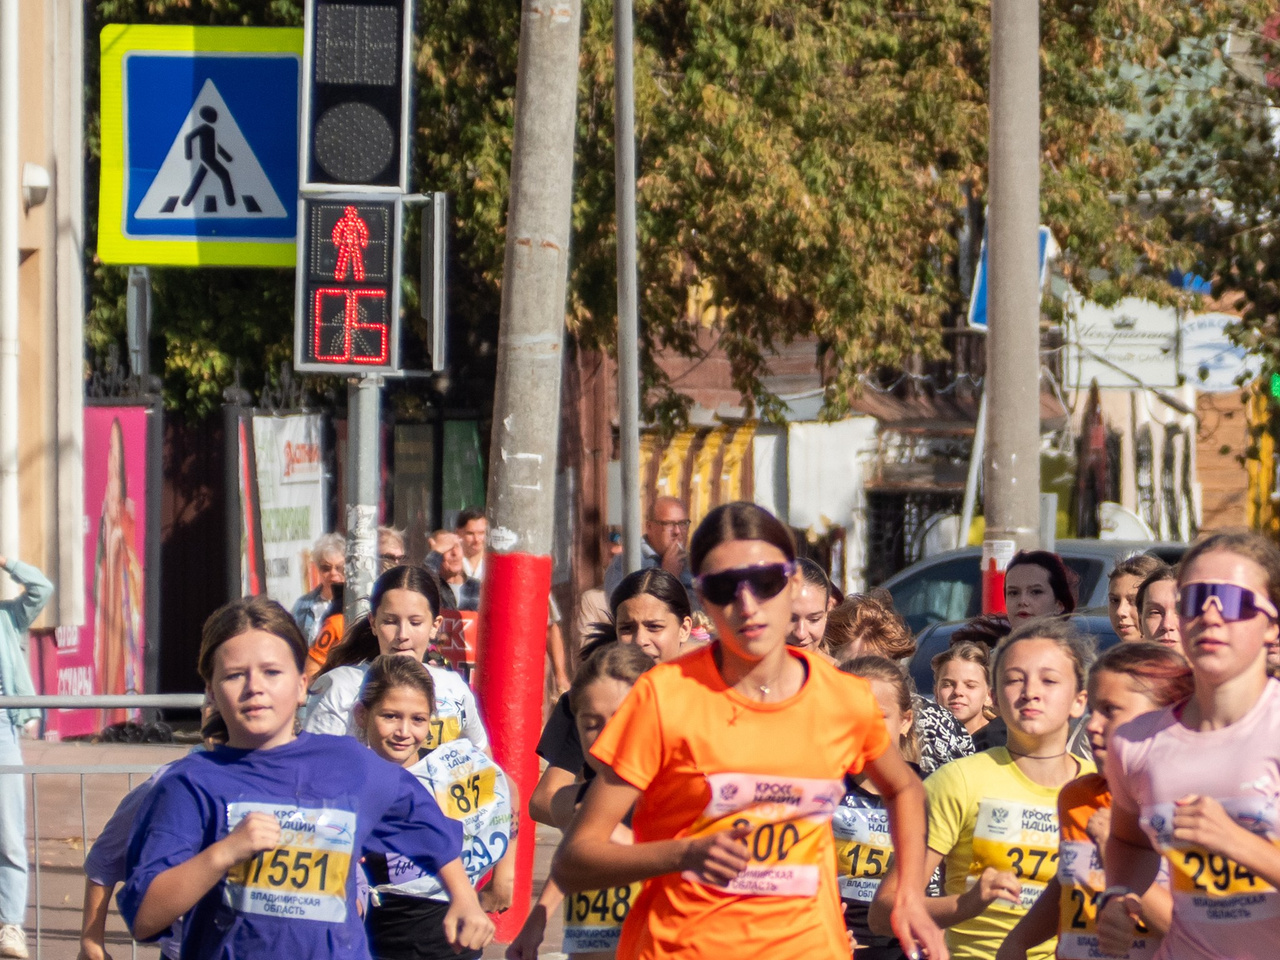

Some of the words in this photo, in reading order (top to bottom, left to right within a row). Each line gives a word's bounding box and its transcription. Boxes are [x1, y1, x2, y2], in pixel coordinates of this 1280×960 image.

[756, 782, 793, 794] КРОСС
[1022, 809, 1052, 822] КРОСС
[279, 820, 316, 832] АЦИИ
[868, 823, 889, 833] НАЦ
[1021, 820, 1060, 833] НАЦИИ
[1184, 852, 1255, 891] 294
[250, 891, 321, 906] ВЛАДИМИРСКАЯ
[263, 904, 306, 915] ОБЛАСТЬ
